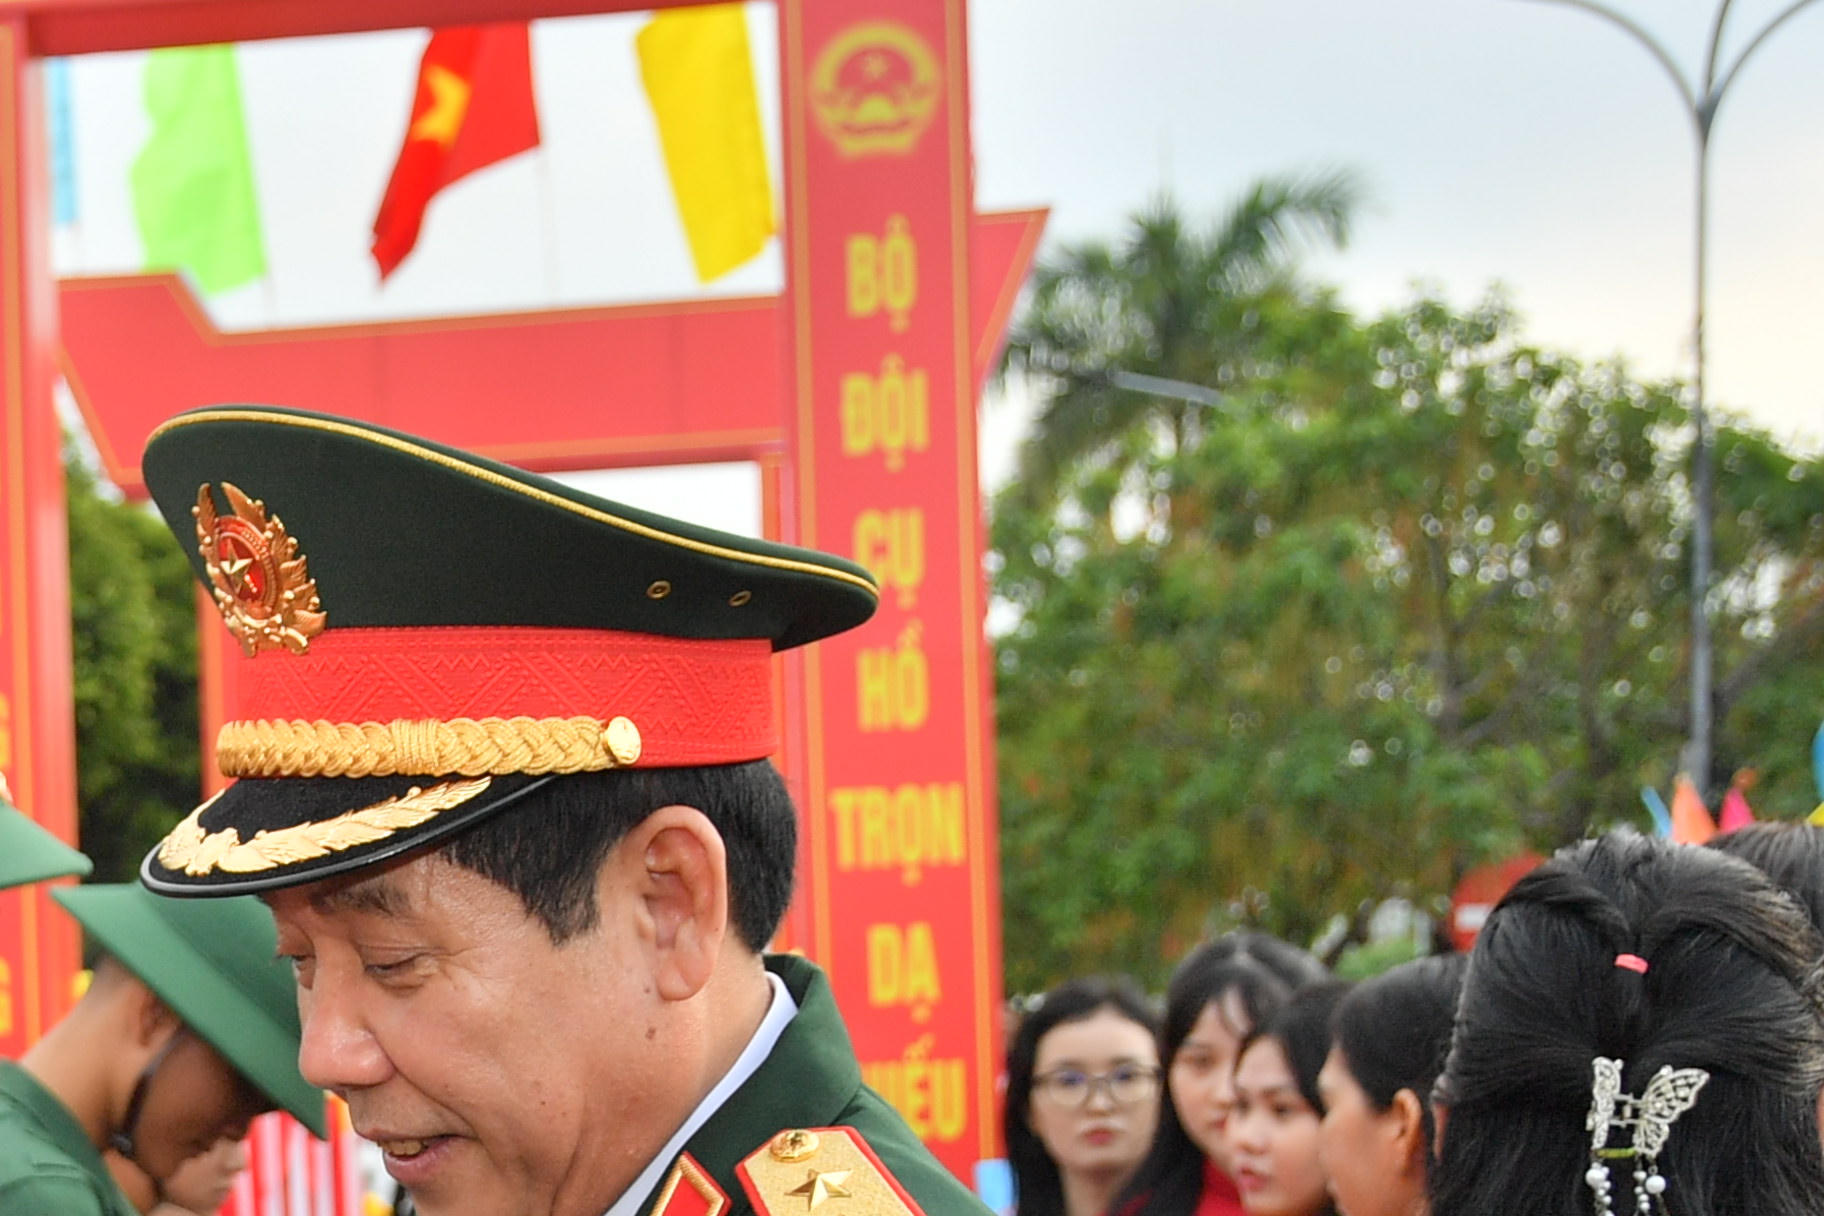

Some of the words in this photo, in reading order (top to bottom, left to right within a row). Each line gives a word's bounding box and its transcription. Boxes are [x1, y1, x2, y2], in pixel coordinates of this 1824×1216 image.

[847, 213, 916, 332] BỘ
[840, 354, 929, 472] ĐỘI
[853, 507, 924, 610] CỤ
[829, 781, 966, 887] TRỌN
[866, 921, 939, 1022] DẠ
